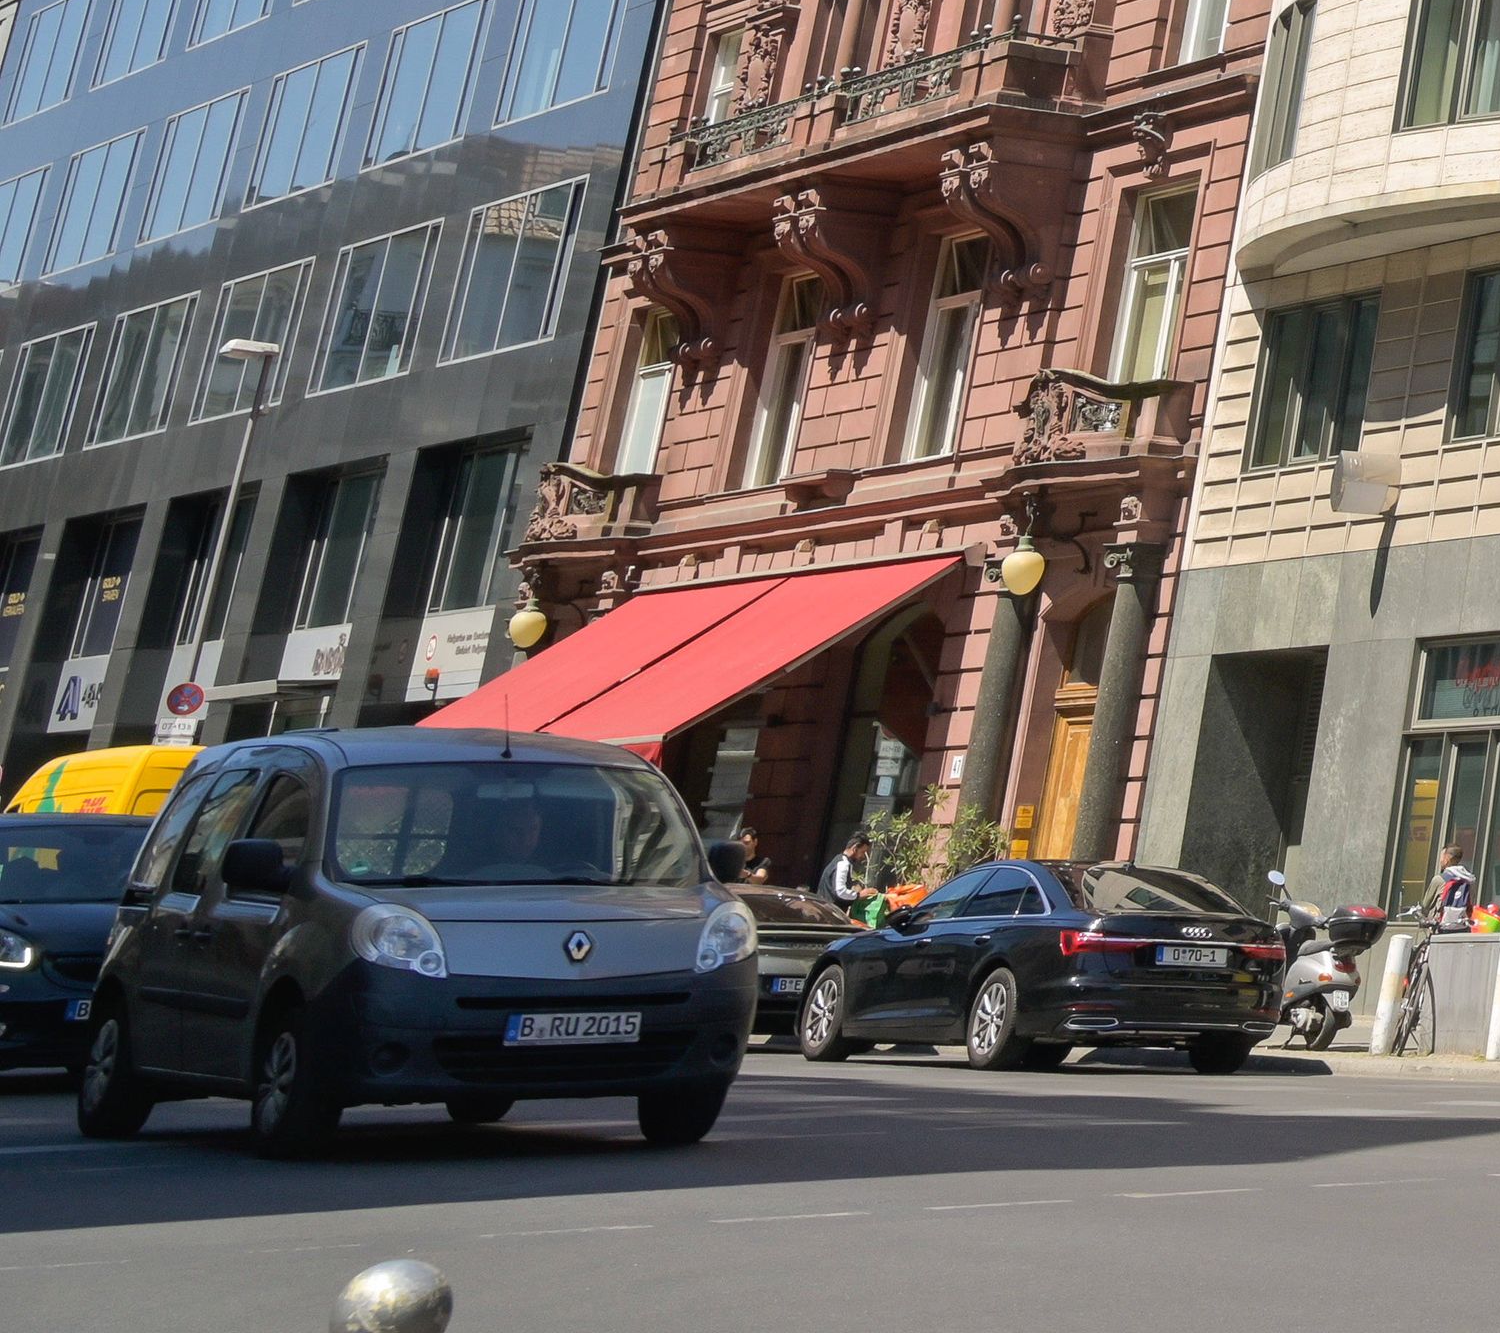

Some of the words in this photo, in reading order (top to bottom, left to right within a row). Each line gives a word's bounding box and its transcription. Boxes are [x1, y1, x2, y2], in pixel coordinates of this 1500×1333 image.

[520, 1017, 535, 1037] B
[550, 1016, 579, 1037] RU
[582, 1015, 638, 1036] 2015
